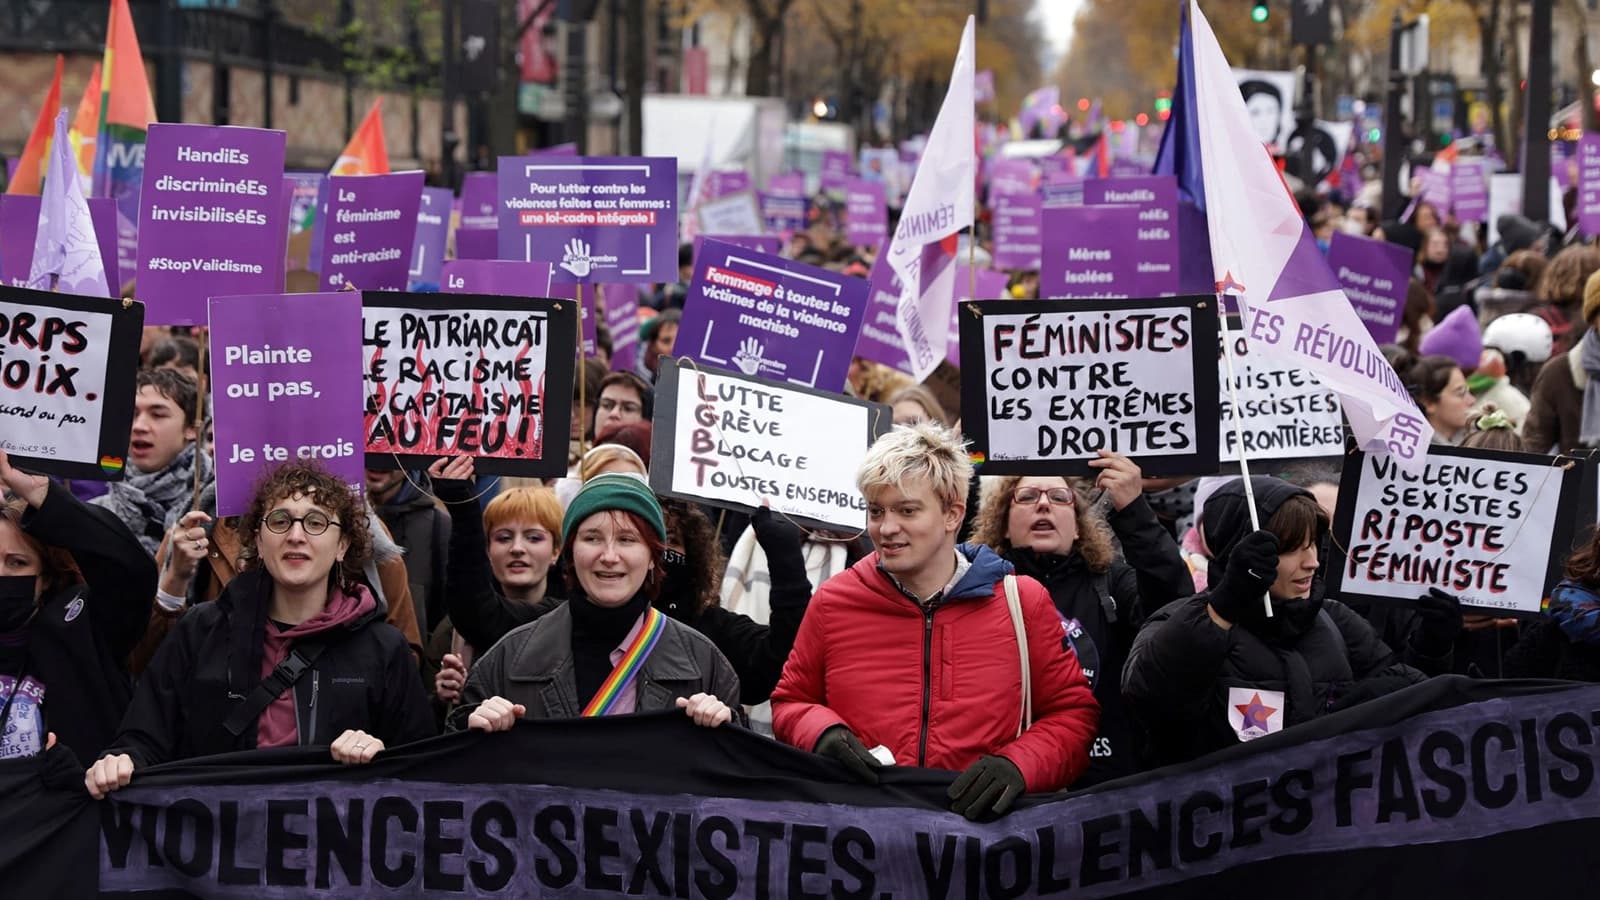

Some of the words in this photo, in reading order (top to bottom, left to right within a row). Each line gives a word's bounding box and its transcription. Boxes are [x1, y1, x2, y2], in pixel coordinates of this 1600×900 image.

[177, 146, 249, 165] HandiEs
[155, 176, 268, 197] discriminéEs
[338, 188, 356, 202] Le
[530, 183, 557, 195] Pour
[559, 183, 590, 194] lutter
[592, 184, 629, 194] contre
[630, 183, 646, 194] les
[505, 197, 557, 209] violences
[558, 198, 592, 209] faites
[594, 200, 617, 209] aux
[618, 199, 666, 209] femmes
[151, 205, 267, 225] invisibiliséEs
[336, 208, 401, 223] féminisme
[521, 215, 543, 224] une
[545, 213, 595, 224] loi-cadre
[596, 212, 649, 226] intégrale
[333, 231, 356, 243] est
[331, 248, 401, 264] anti-raciste
[1069, 247, 1111, 260] Mères
[149, 258, 262, 274] #StopValidisme
[1065, 270, 1114, 283] isolées
[329, 273, 344, 285] et
[448, 274, 465, 288] Le
[1339, 266, 1372, 286] Pour
[1373, 278, 1393, 291] un
[706, 267, 773, 296] Femmage
[774, 282, 785, 299] à
[787, 288, 830, 312] toutes
[831, 299, 851, 317] les
[702, 284, 756, 311] victimes
[757, 298, 775, 315] de
[776, 302, 790, 317] la
[792, 308, 847, 334] violence
[738, 312, 800, 338] machiste
[225, 344, 313, 366] Plainte
[991, 362, 1133, 391] CONTRE
[227, 383, 259, 398] ou
[268, 380, 322, 402] pas,
[697, 374, 784, 414] LUTTE
[991, 398, 1033, 421] LES
[1050, 388, 1193, 420] EXTRÊMES
[38, 411, 56, 420] ou
[57, 414, 87, 428] pas
[694, 404, 782, 437] GRÈVE
[366, 415, 423, 451] AU
[437, 418, 503, 454] FEU
[515, 417, 531, 456] !
[229, 444, 255, 464] Je
[263, 443, 289, 462] te
[296, 438, 354, 460] crois
[691, 428, 808, 470] BLOCAGE
[690, 457, 780, 496] TOUSTES
[100, 795, 518, 894] VIOLENCES
[915, 767, 1315, 900] VIOLENCES
[1336, 707, 1600, 830] FASCIS
